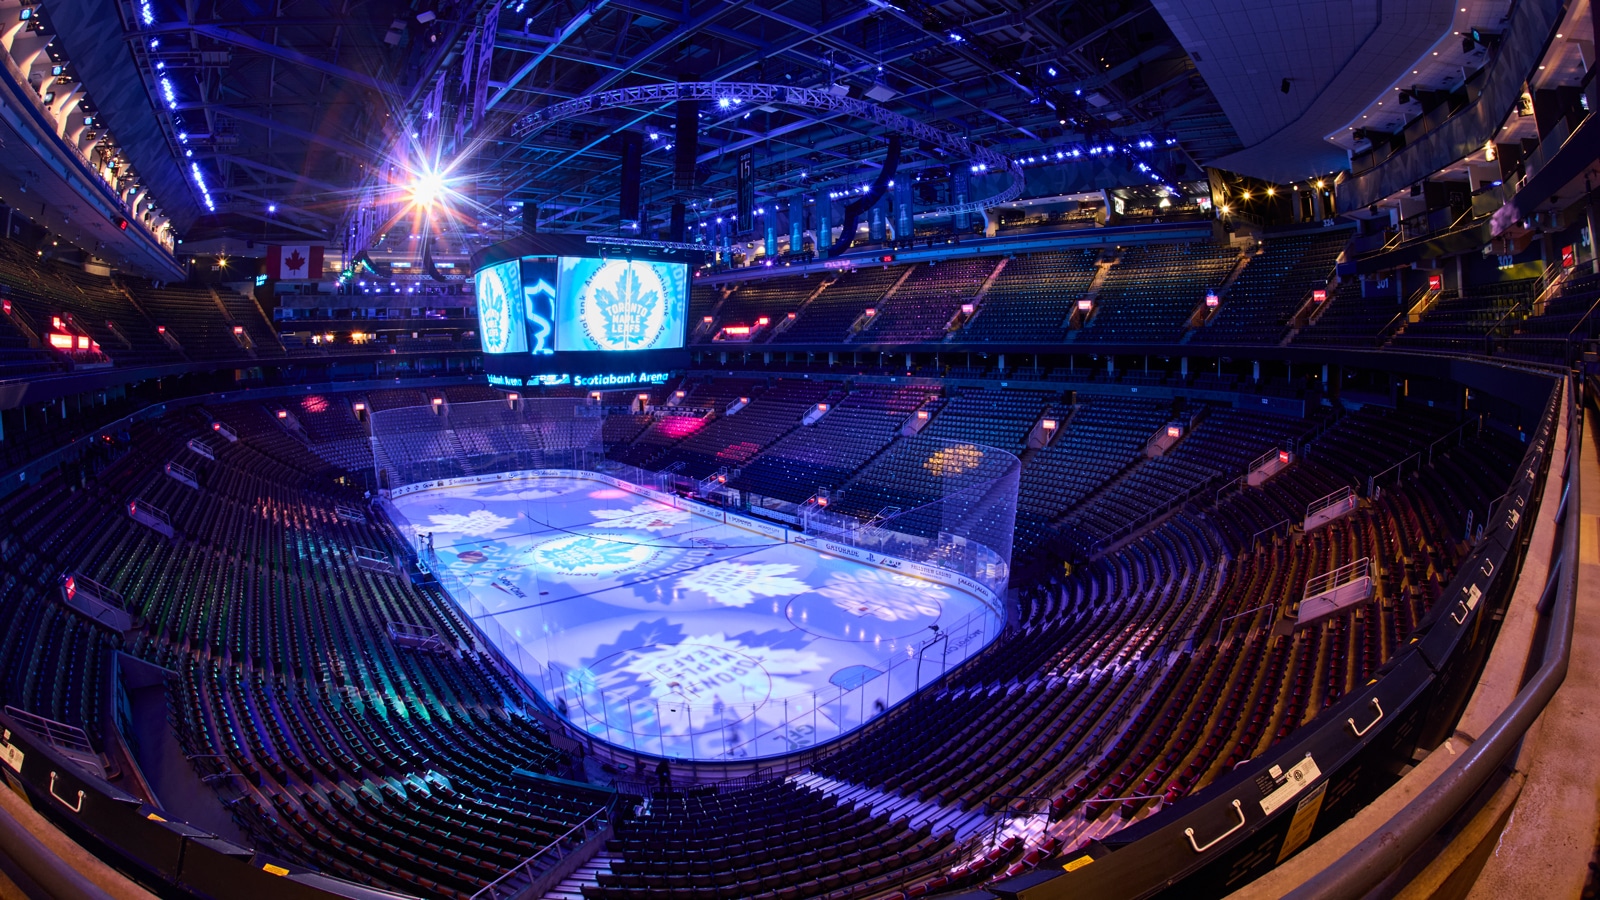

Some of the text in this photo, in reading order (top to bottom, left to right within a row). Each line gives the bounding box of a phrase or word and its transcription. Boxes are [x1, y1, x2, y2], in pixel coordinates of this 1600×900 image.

[1498, 254, 1514, 270] 302
[605, 302, 648, 317] TORONTO
[612, 314, 641, 323] MAPLE
[574, 372, 669, 386] Scotiabank Arena
[825, 543, 860, 558] GATORADE
